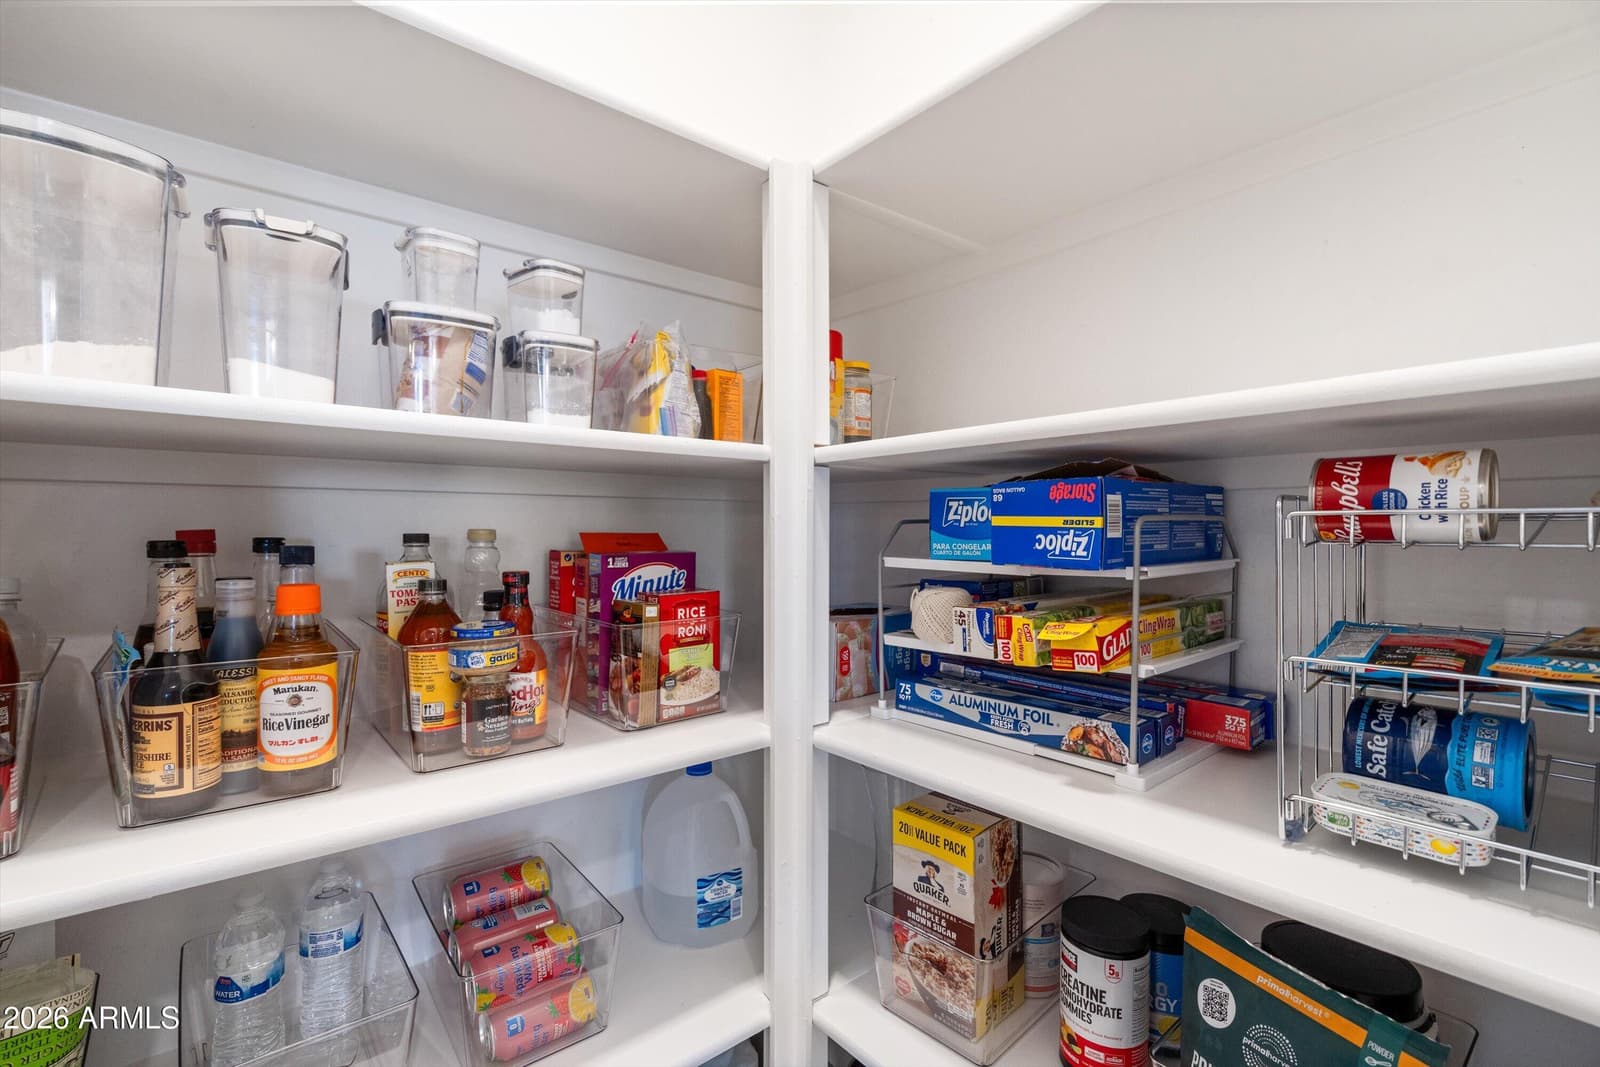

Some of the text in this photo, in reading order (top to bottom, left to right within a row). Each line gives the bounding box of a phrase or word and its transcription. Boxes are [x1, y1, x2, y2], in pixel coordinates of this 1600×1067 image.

[992, 494, 1003, 502] 68
[1050, 481, 1097, 503] Storage
[1459, 487, 1470, 509] OUP
[1419, 482, 1432, 521] Cicken
[1435, 478, 1449, 524] wh Rice
[947, 500, 991, 527] Ziplo
[951, 543, 991, 551] CONGELAR
[1035, 529, 1089, 557] Ziploc
[607, 557, 614, 569] 1
[397, 569, 426, 577] CENTO
[613, 567, 686, 601] Minute
[389, 588, 420, 598] TOMA
[396, 597, 420, 608] PAS
[677, 606, 706, 619] RICE
[958, 610, 966, 626] 45
[677, 624, 706, 639] RONI
[1001, 641, 1012, 660] 100
[1141, 643, 1152, 655] 100
[489, 652, 516, 665] garlic
[1075, 653, 1096, 666] 100
[216, 666, 256, 678] ALESSI
[220, 689, 256, 699] ALSAMIC
[273, 685, 316, 695] Marukan
[511, 684, 545, 701] edHot
[899, 683, 911, 695] 75
[948, 693, 1019, 719] ALUMINUM
[1023, 709, 1054, 726] FOIL
[134, 719, 173, 732] ERRINS
[262, 713, 330, 731] Rice Vinegar
[990, 718, 1014, 730] FRESH
[1224, 714, 1247, 728] 375
[1225, 723, 1236, 731] SQ
[1366, 735, 1389, 779] Safe
[898, 820, 967, 858] 20 VALUE PACK
[913, 881, 949, 907] QUAKER
[915, 906, 940, 924] MAPLE
[907, 910, 932, 928] BROWN
[932, 923, 958, 940] SUGAR
[995, 917, 1004, 954] UAKER
[1061, 965, 1107, 1005] CREATINE
[47, 987, 90, 1007] RIGINAL
[1255, 974, 1323, 1018] primalharvest
[1242, 1036, 1291, 1067] primalharve
[1367, 1040, 1395, 1061] POWDER
